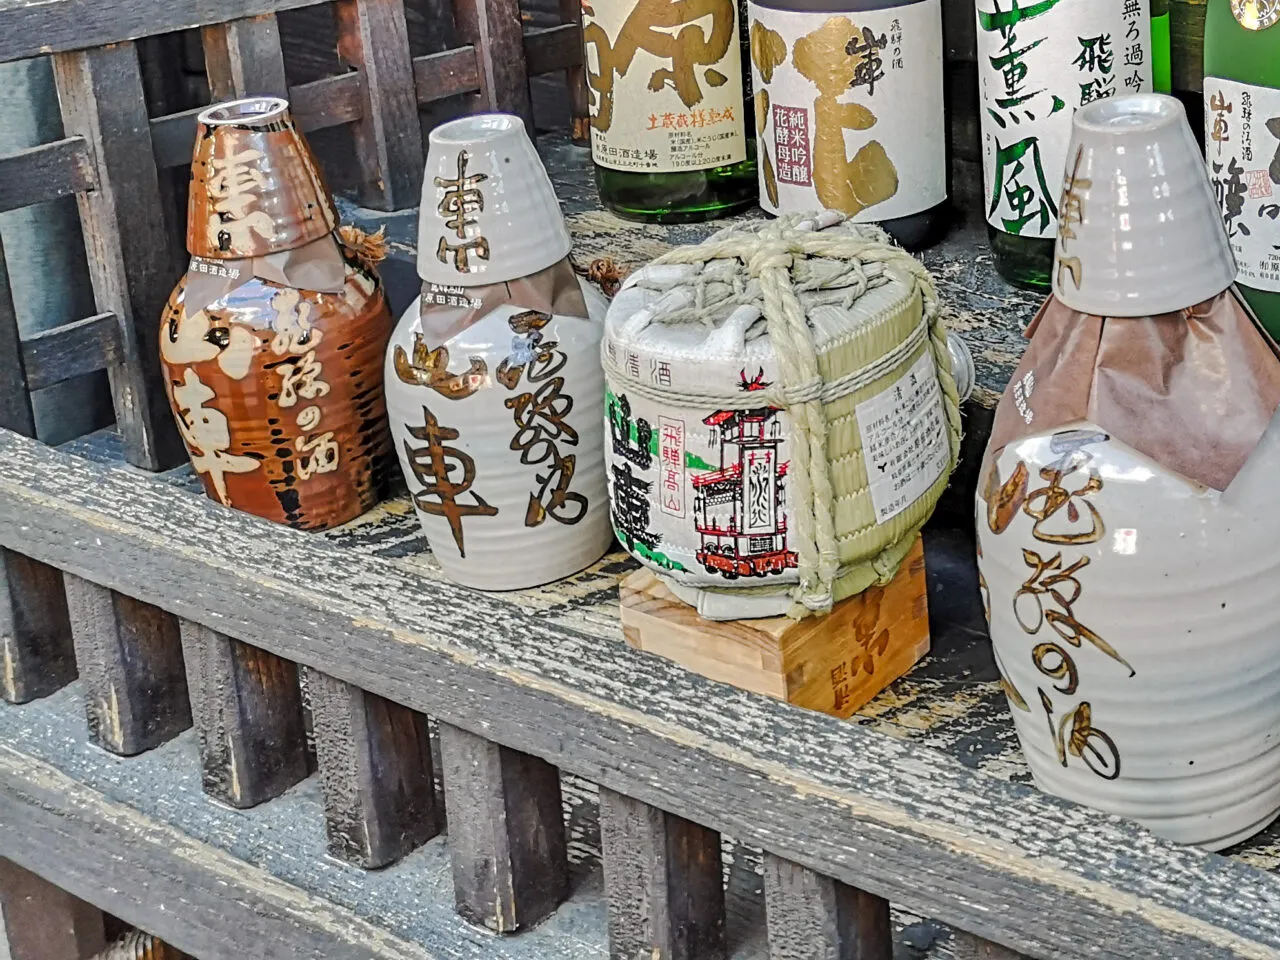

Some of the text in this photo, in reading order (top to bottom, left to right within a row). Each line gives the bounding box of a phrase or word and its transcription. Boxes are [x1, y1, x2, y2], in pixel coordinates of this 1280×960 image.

[774, 108, 791, 181] 花酵母造
[790, 111, 808, 184] 純米吟醸
